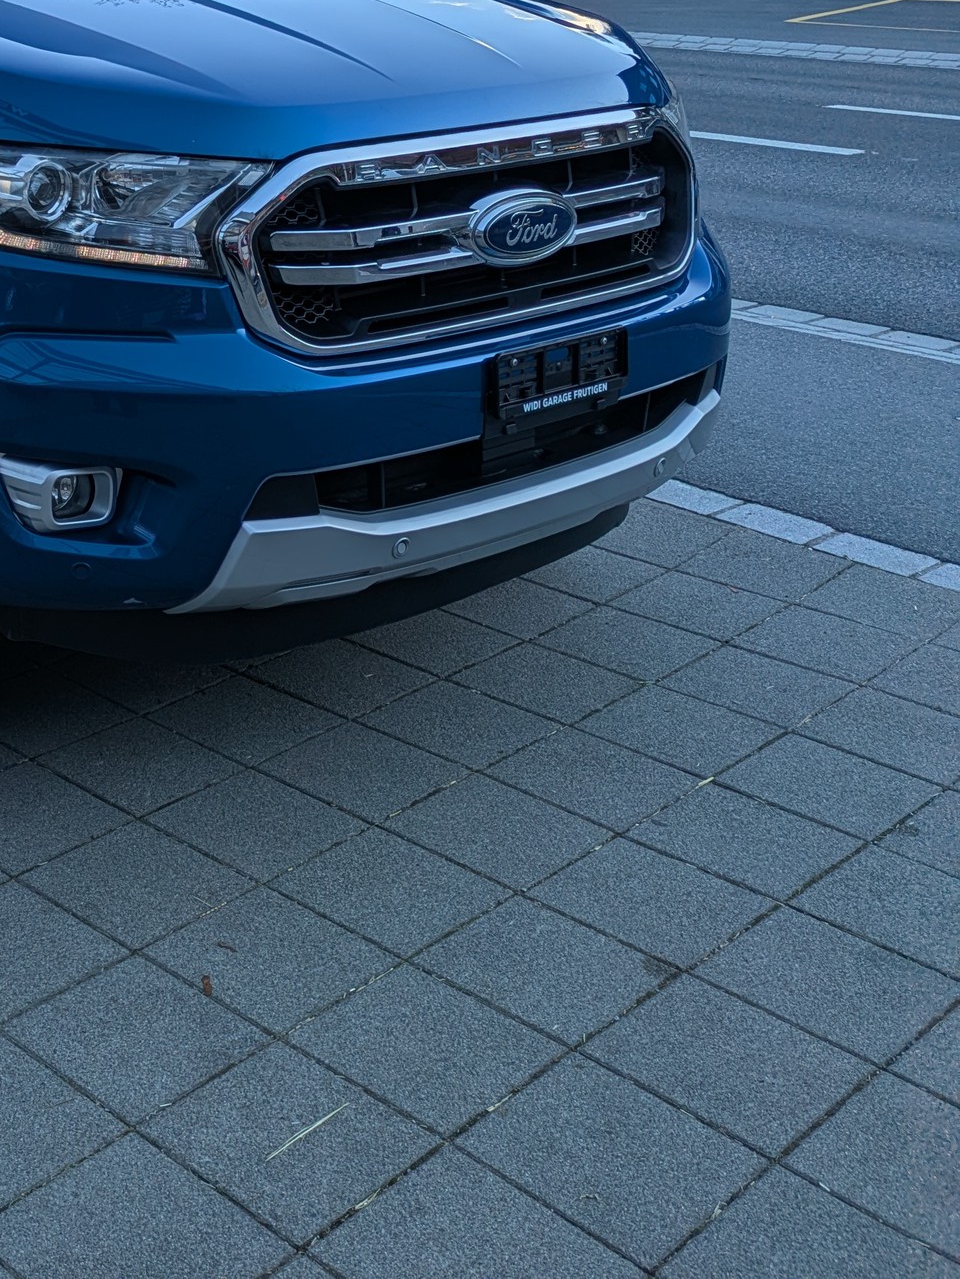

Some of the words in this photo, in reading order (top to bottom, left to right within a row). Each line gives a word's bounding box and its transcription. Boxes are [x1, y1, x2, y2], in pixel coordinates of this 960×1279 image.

[355, 123, 645, 182] RANGER
[506, 208, 558, 247] Ford
[523, 400, 541, 413] WIDI
[542, 392, 573, 408] GARAGE
[573, 382, 608, 399] FRUTIGEN
